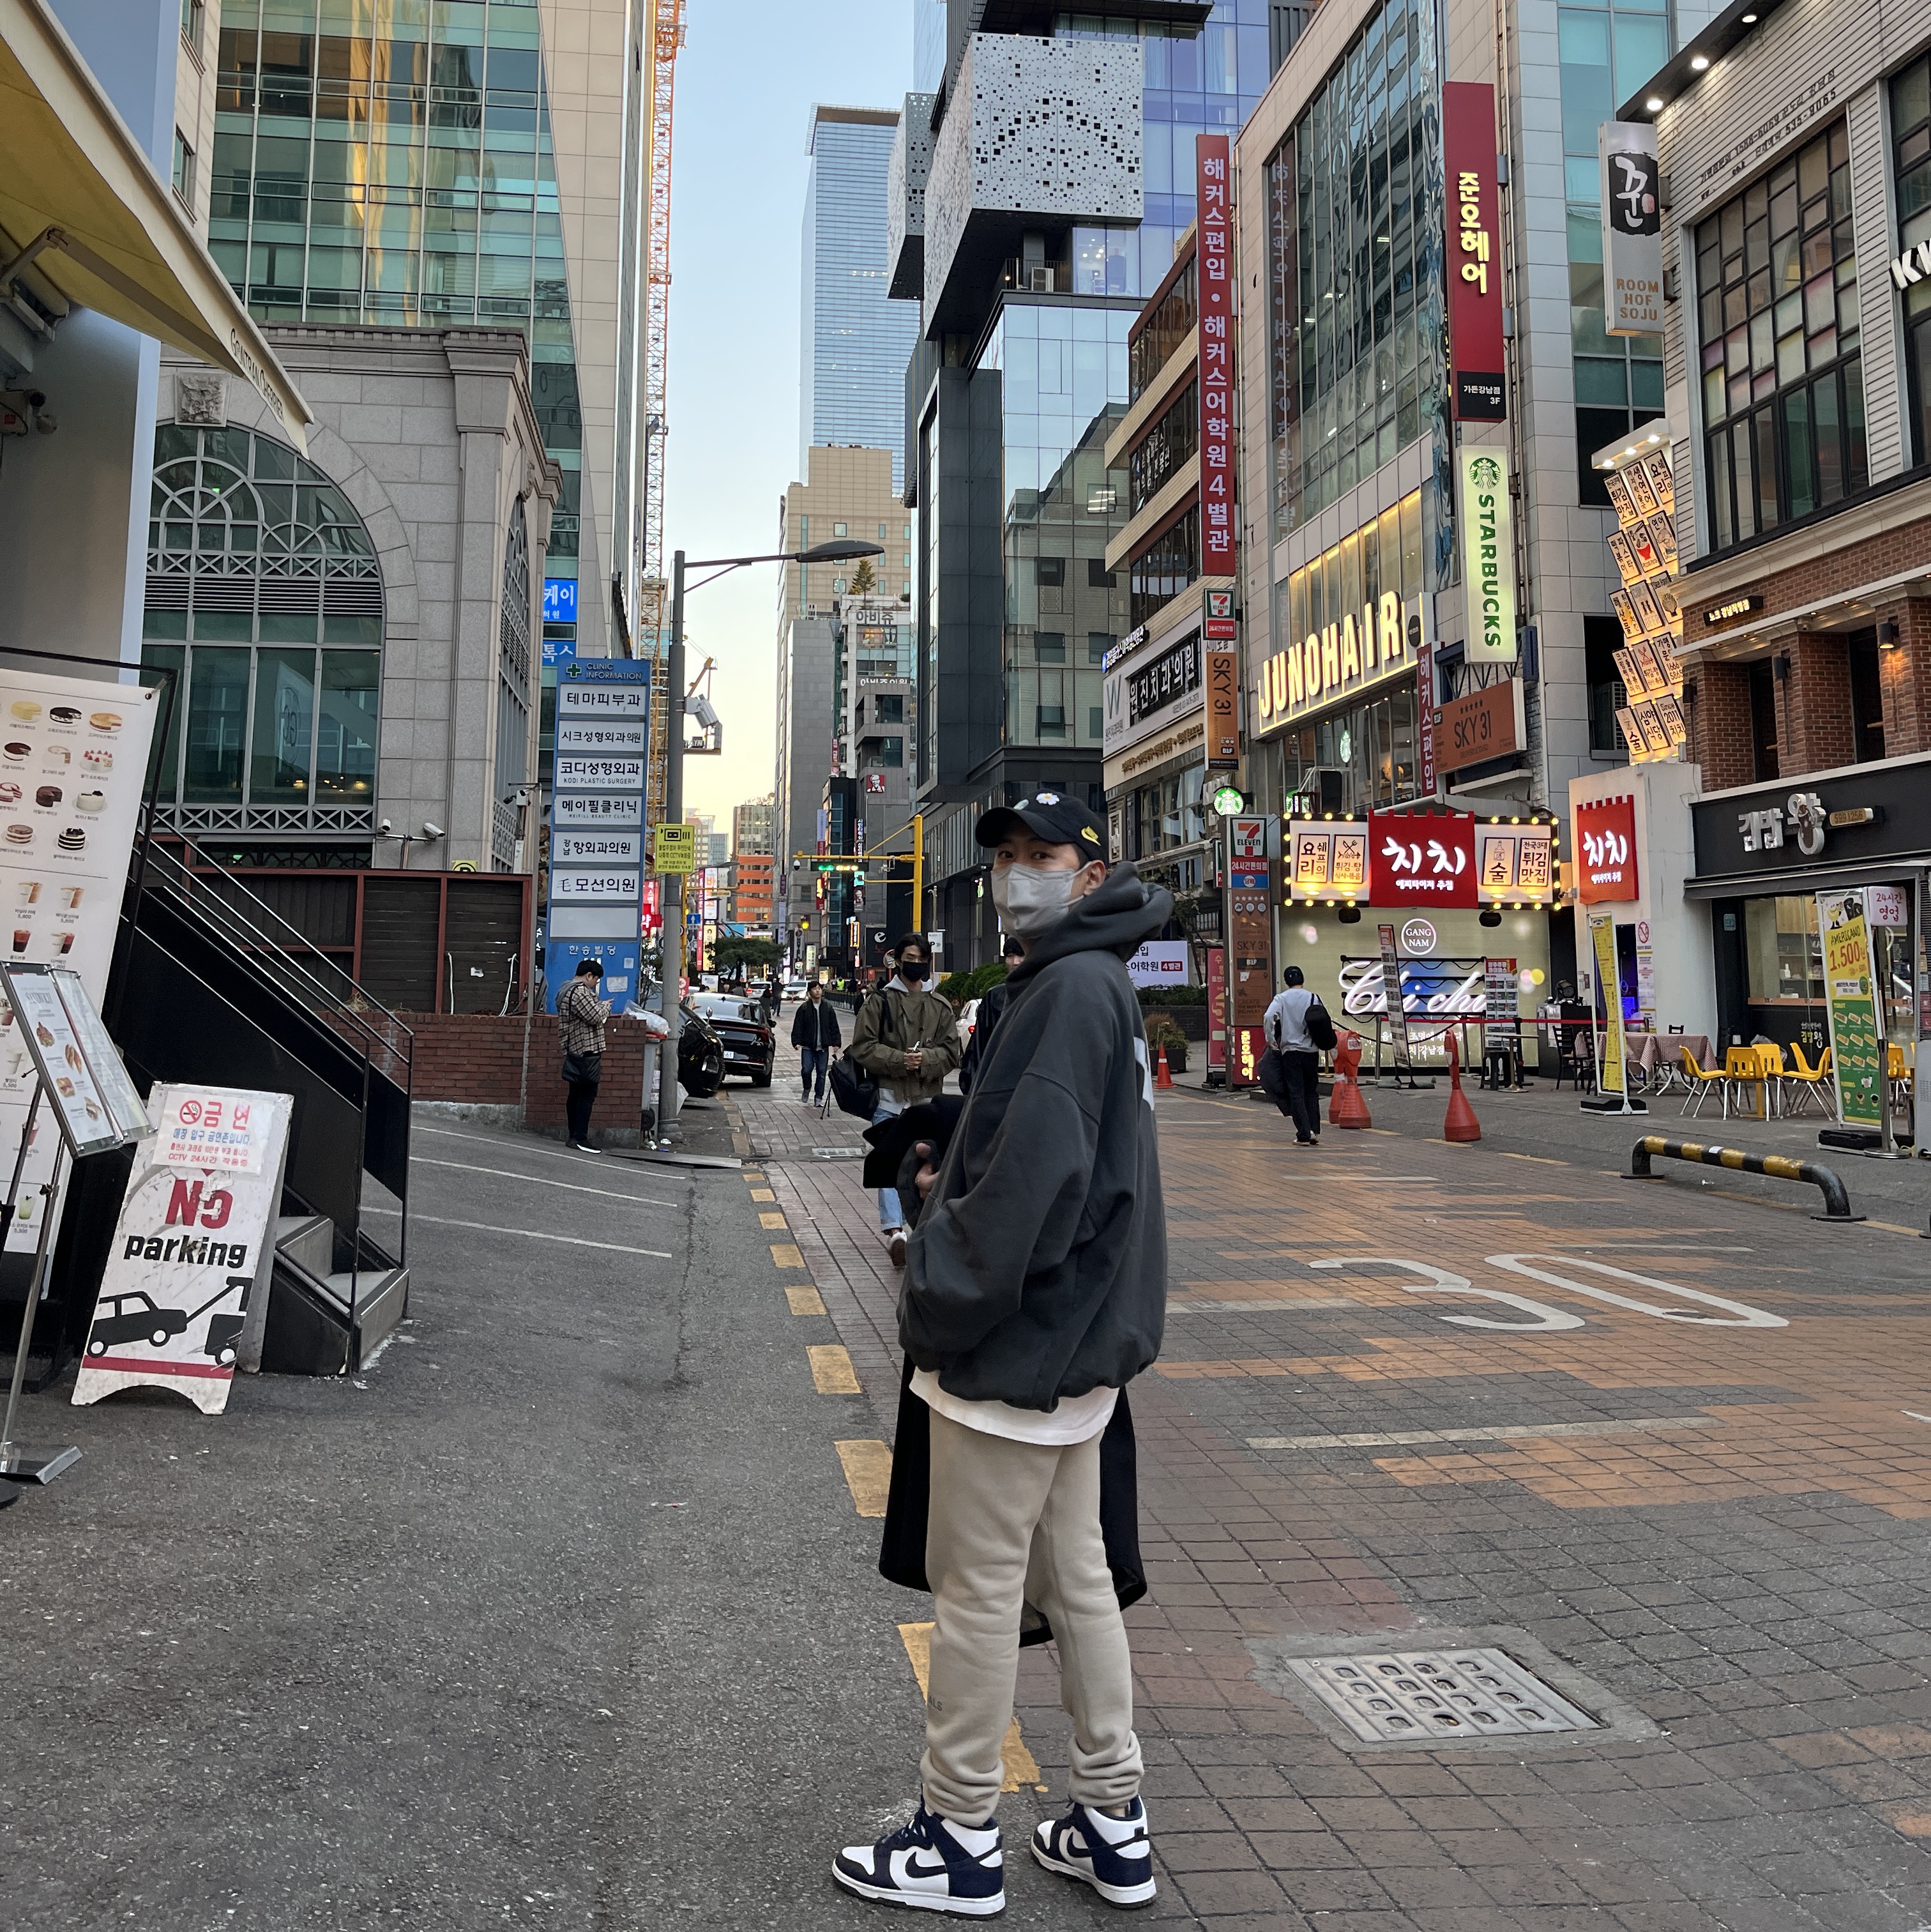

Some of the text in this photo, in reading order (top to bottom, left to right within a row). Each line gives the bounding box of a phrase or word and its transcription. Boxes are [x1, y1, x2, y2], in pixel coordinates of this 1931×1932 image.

[1615, 156, 1648, 228] 꾼
[1204, 158, 1225, 280] 해커스편입
[1458, 172, 1490, 295] 준오헤어
[1616, 278, 1659, 293] ROOM
[1624, 293, 1653, 307] HOF
[1619, 307, 1658, 321] SOJU
[1490, 397, 1501, 406] 3F
[1633, 466, 1654, 506] 생연어
[1651, 464, 1670, 494] 요리
[1611, 486, 1628, 503] 튀김
[1616, 501, 1635, 520] 맛집
[1651, 515, 1666, 531] 연어
[1478, 494, 1502, 647] STARBUCKS
[856, 611, 895, 626] 아비쥬
[1261, 590, 1401, 719] JUNOHAIR
[586, 671, 642, 680] INFORMATION
[1130, 642, 1195, 716] 원진치과의원
[1213, 657, 1231, 696] SKY
[566, 693, 641, 707] 테마피부과
[1106, 674, 1122, 720] W
[1214, 699, 1232, 716] 31
[1420, 652, 1434, 791] 해커스편입
[1640, 708, 1656, 726] 심야
[1663, 710, 1681, 724] 2011
[561, 731, 641, 744] 시크성형외과의원
[1454, 714, 1478, 749] SKY
[1480, 709, 1492, 739] 31
[1629, 731, 1643, 752] 술
[561, 762, 640, 775] 코디성형외과
[562, 800, 637, 814] 메이필클리닉
[563, 839, 631, 856] 강남 항외과의원
[1523, 841, 1548, 850] 전국3대
[1582, 830, 1628, 868] 치치
[1300, 841, 1316, 876] 요리
[1381, 836, 1466, 875] 치치
[1522, 851, 1547, 867] 튀김
[1488, 862, 1508, 883] 술
[1522, 868, 1545, 884] 맛집
[575, 878, 635, 892] 모션의원
[1876, 892, 1903, 904] 24시간
[1879, 905, 1899, 922] 영업
[1405, 928, 1432, 937] GANG
[1831, 925, 1861, 947] AMERICANO
[569, 945, 616, 956] 한승빌딩
[1237, 941, 1267, 951] SKY 31
[1409, 938, 1430, 947] NAM
[191, 1129, 205, 1141] 입구
[168, 1153, 187, 1161] CCTV
[190, 1155, 217, 1164] 24시간
[123, 1235, 248, 1269] parking
[1308, 1253, 1790, 1328] 30
